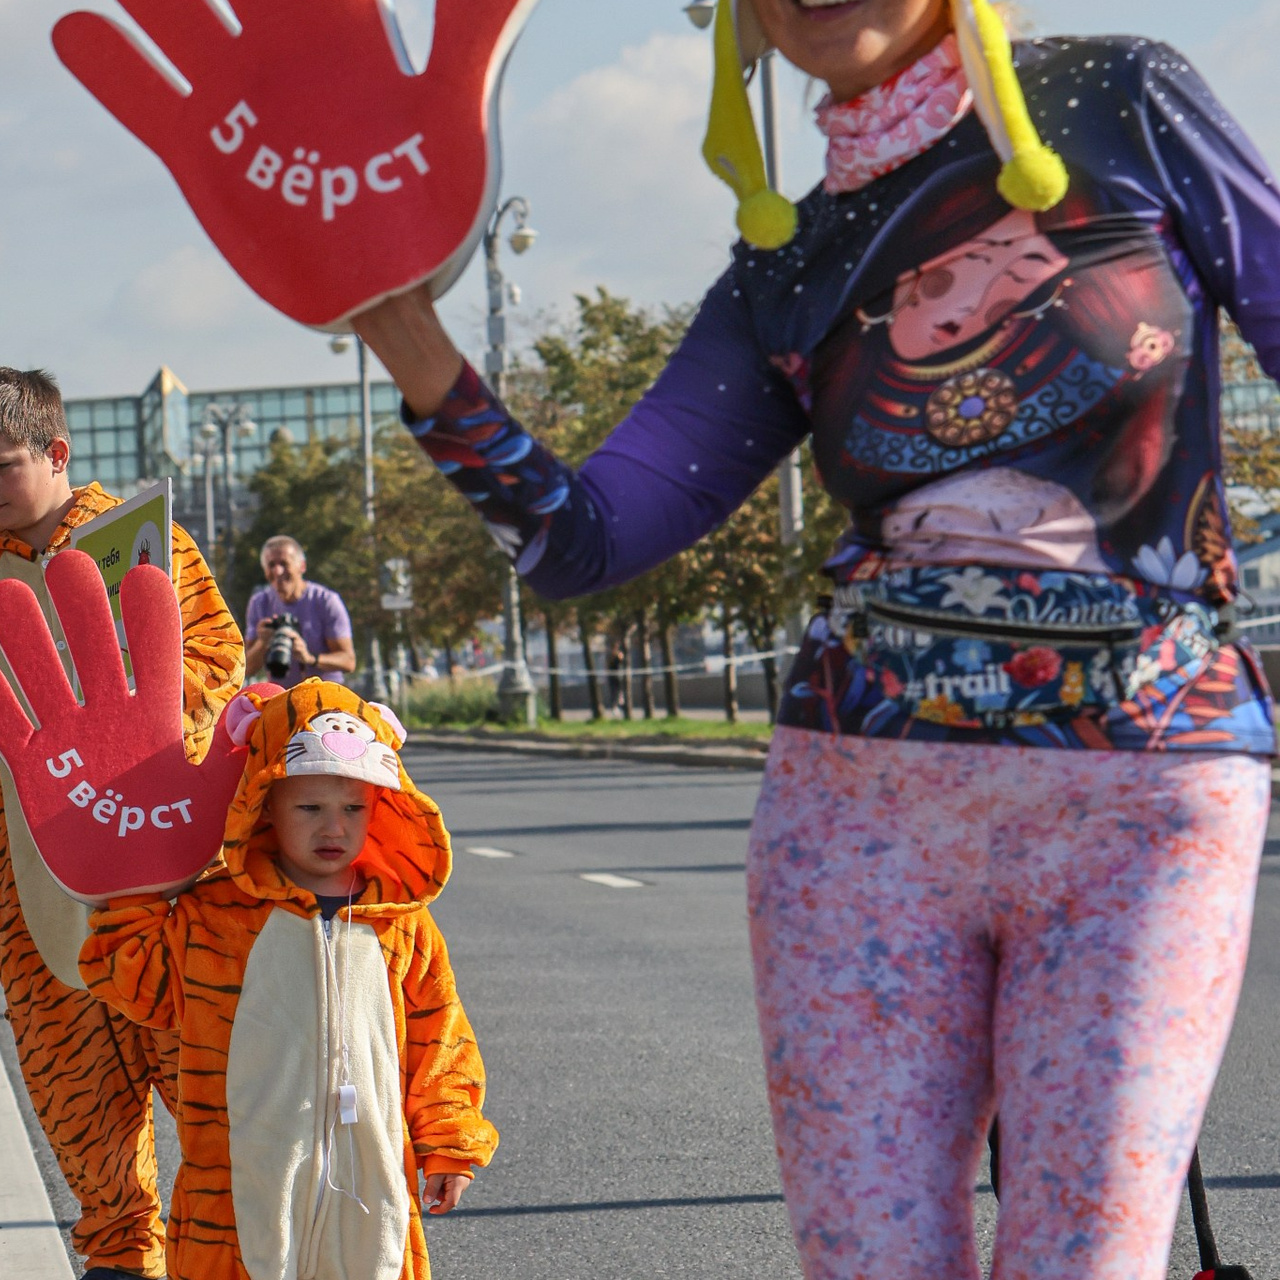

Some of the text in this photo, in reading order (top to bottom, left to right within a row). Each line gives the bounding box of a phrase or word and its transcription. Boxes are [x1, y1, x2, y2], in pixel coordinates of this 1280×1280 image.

[210, 100, 431, 222] 5 вёрст
[102, 547, 120, 570] тебя
[903, 662, 1012, 702] #trail
[45, 747, 194, 838] 5 вёрст
